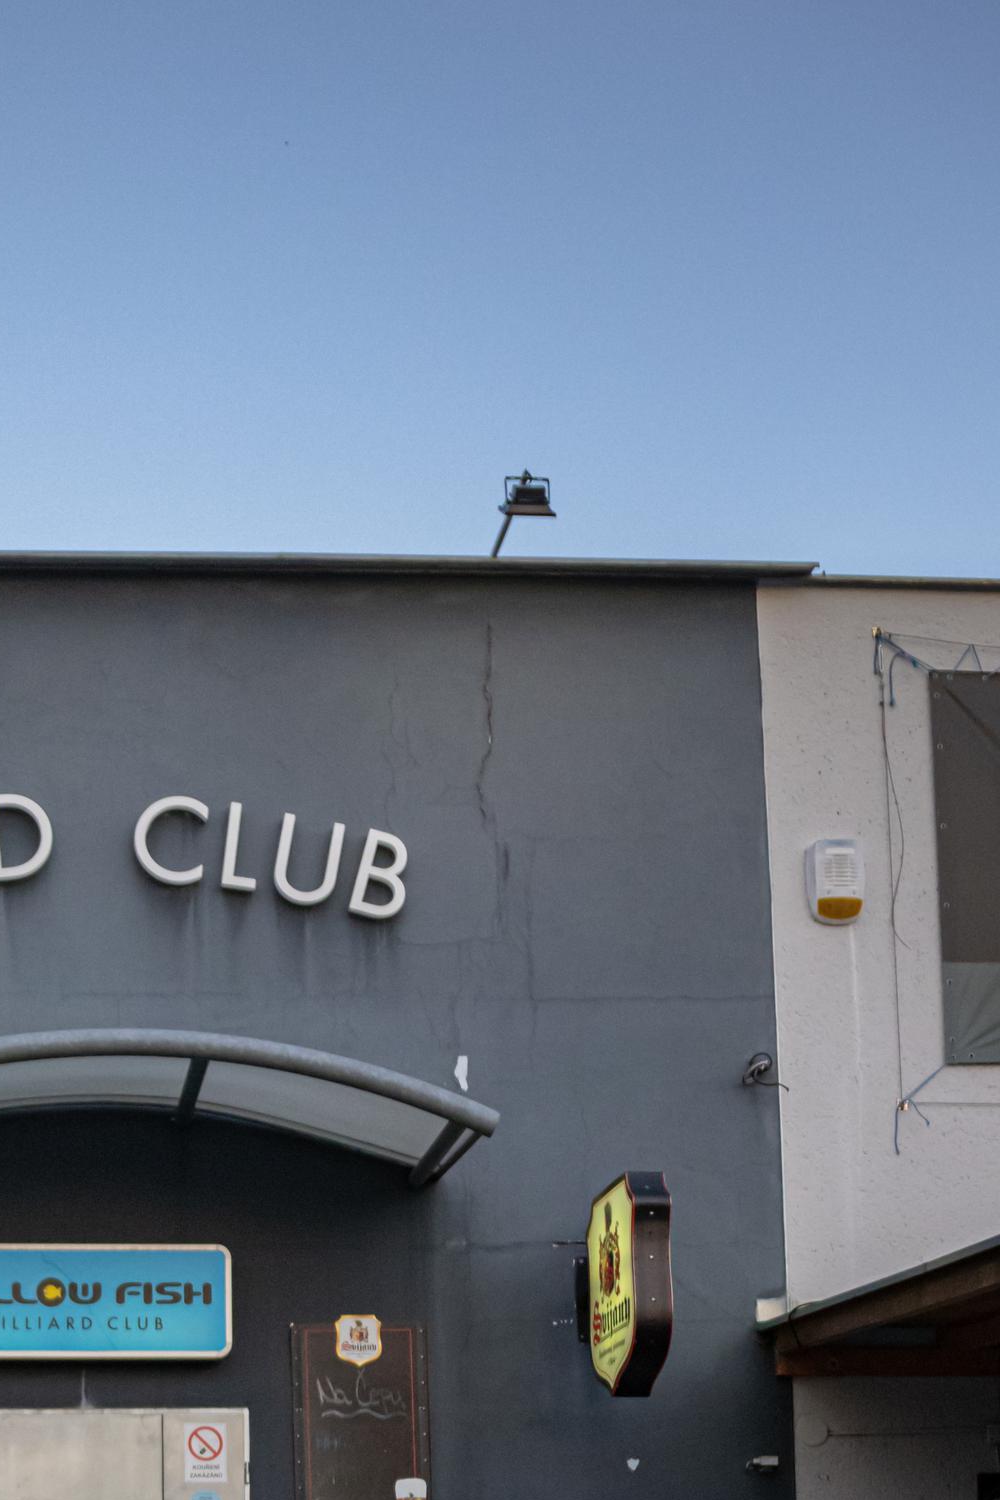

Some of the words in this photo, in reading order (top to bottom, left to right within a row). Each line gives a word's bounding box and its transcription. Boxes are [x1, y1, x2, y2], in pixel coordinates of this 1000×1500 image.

[133, 795, 409, 920] CLUB
[115, 1281, 213, 1305] FISH
[107, 1316, 165, 1331] CLUB
[592, 1296, 631, 1347] Svijany
